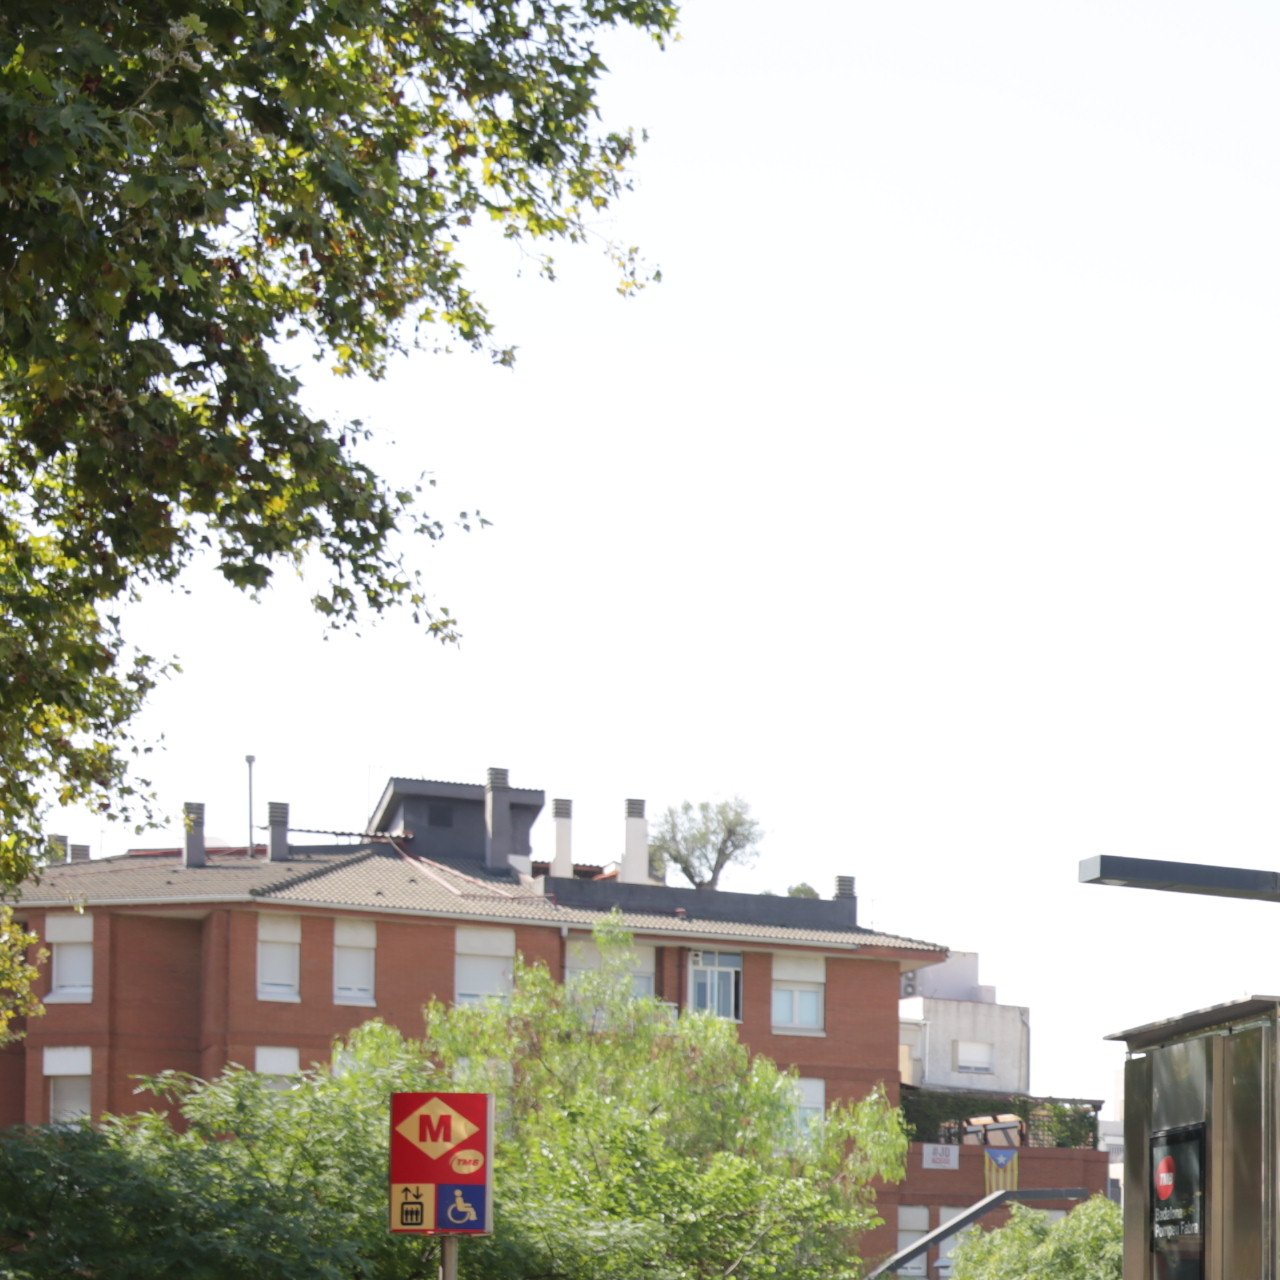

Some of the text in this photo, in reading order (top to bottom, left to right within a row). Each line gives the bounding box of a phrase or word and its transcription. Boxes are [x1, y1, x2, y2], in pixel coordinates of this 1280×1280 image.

[419, 1113, 453, 1143] M
[457, 1158, 480, 1167] TMB
[1154, 1224, 1179, 1239] Pompeu
